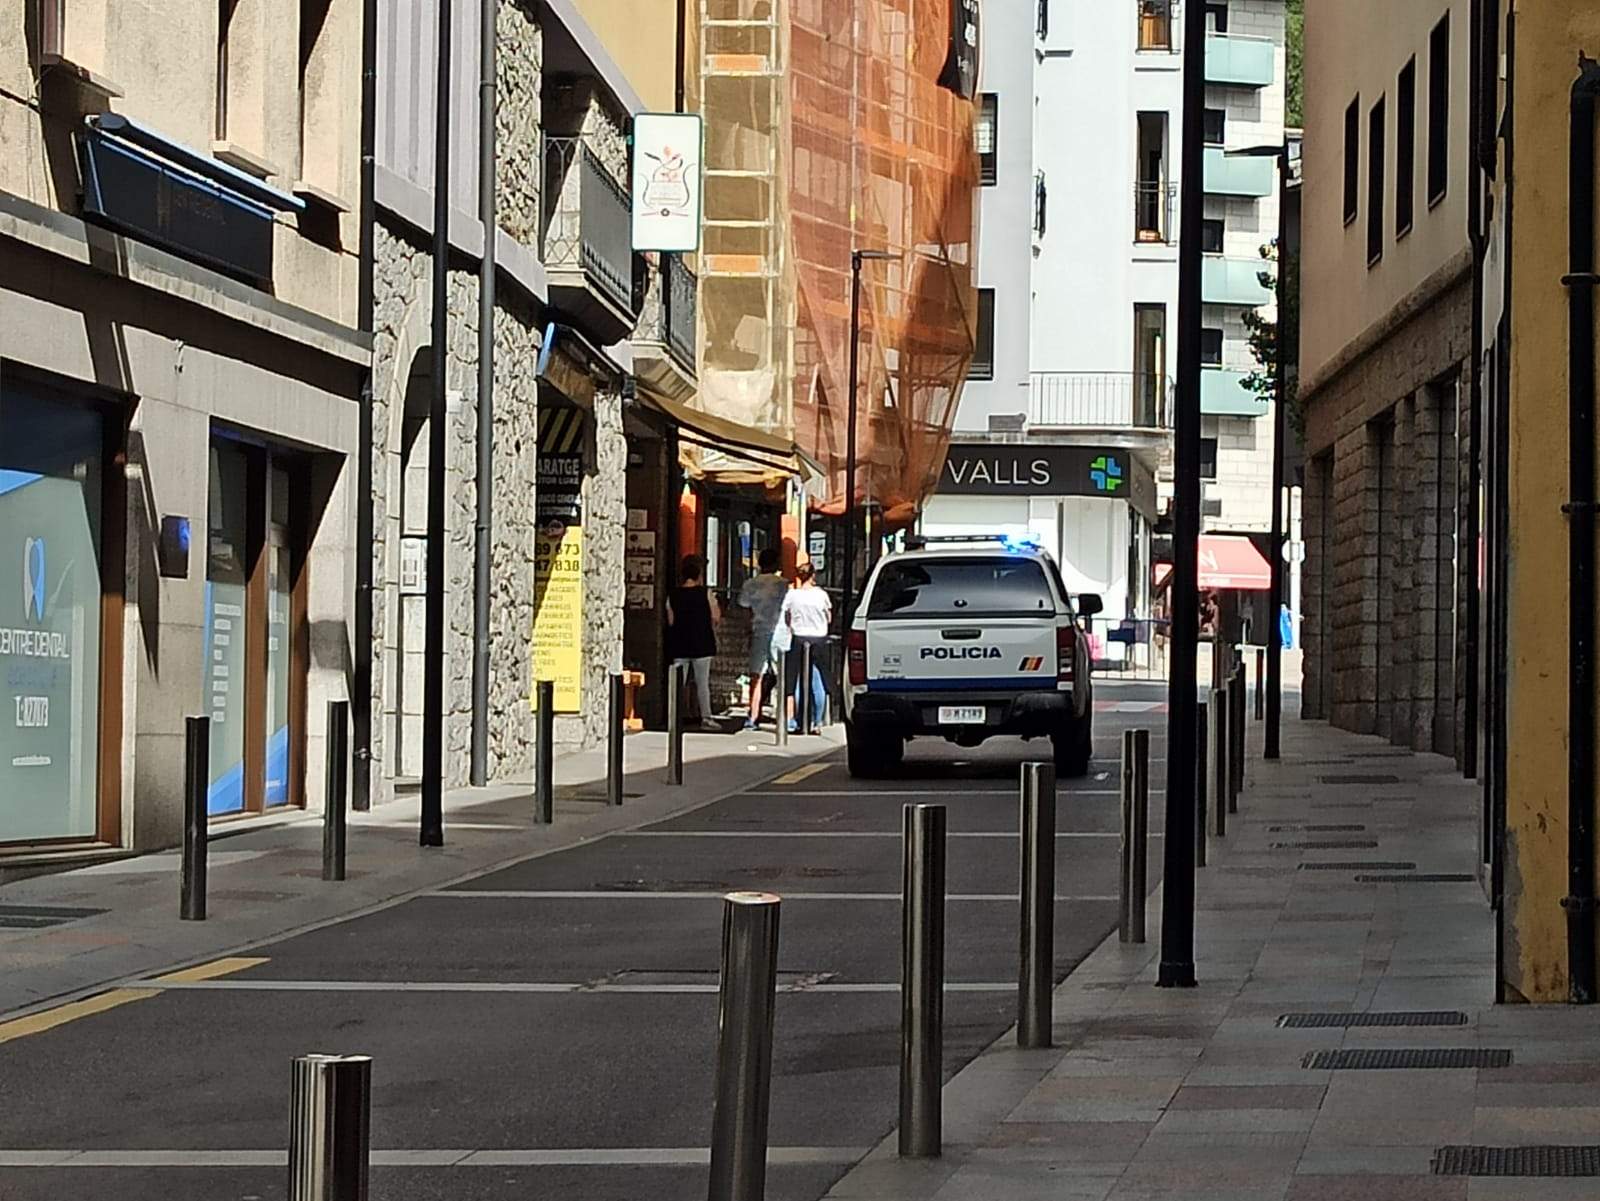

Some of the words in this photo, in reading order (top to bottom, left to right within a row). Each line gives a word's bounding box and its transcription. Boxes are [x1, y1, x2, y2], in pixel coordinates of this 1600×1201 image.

[947, 459, 1050, 485] VALLS
[34, 631, 70, 658] DENTAL
[920, 646, 1002, 660] POLICIA
